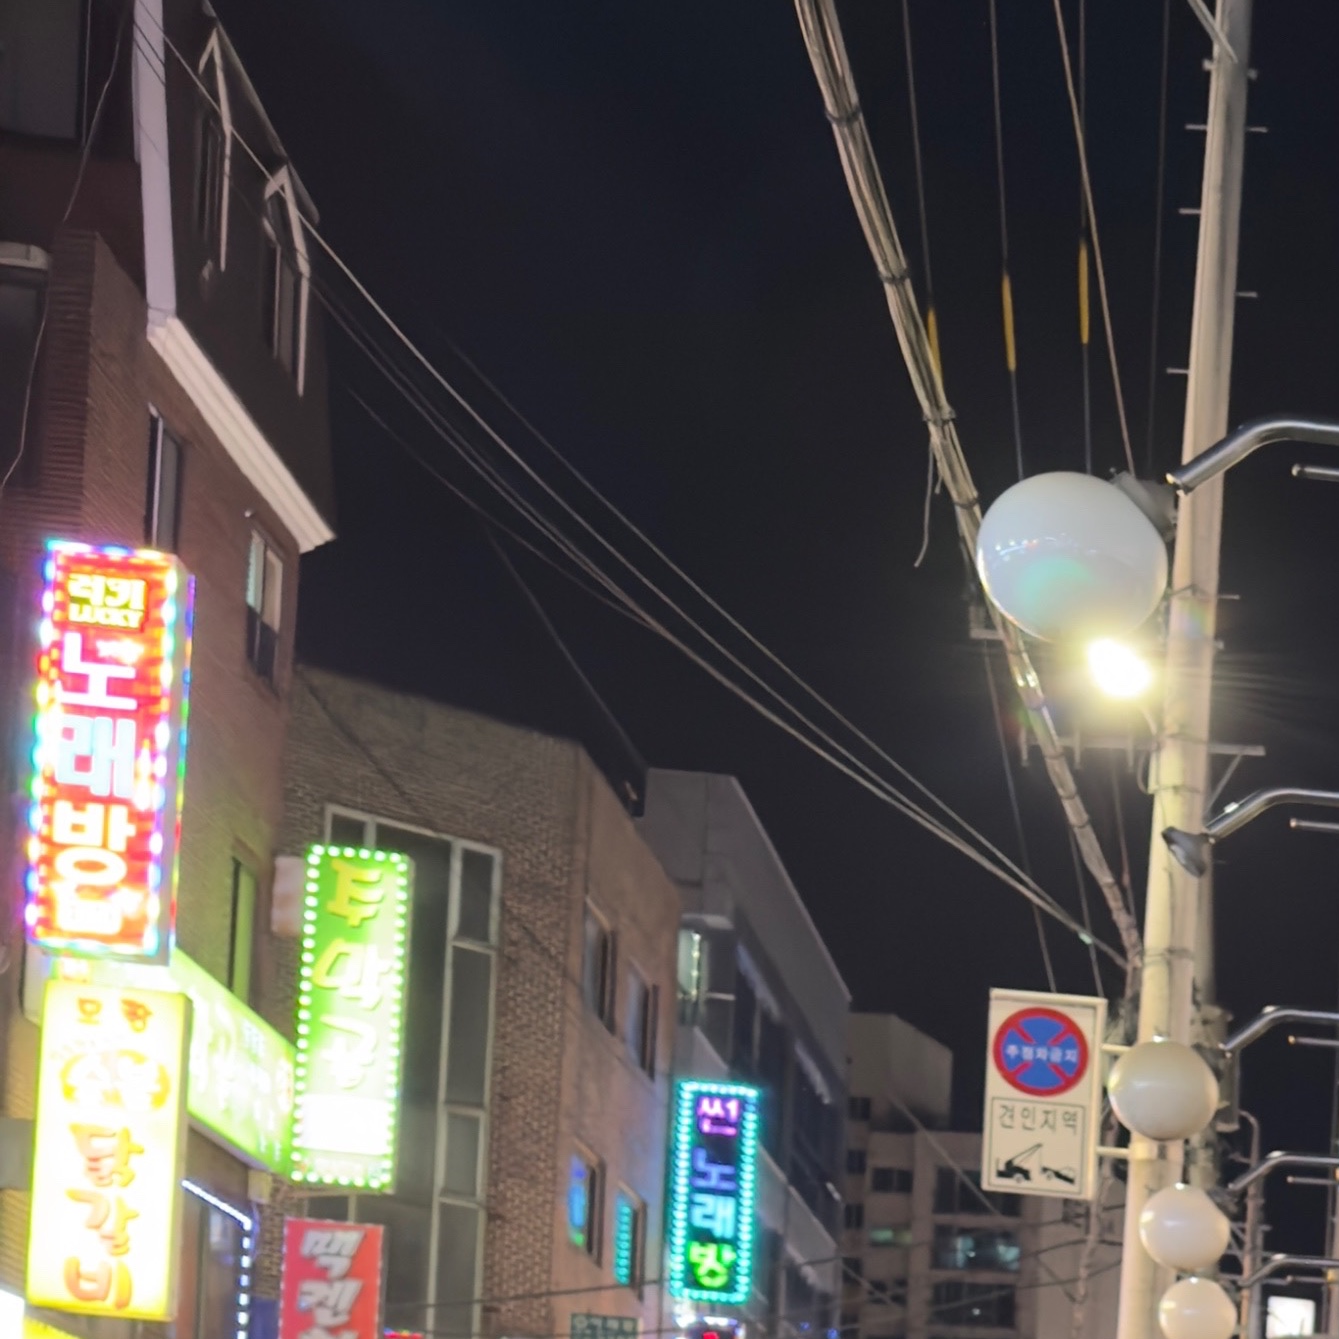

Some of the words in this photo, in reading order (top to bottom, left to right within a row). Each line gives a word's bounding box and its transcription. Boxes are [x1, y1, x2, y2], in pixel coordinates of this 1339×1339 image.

[68, 573, 147, 610] 럭키
[68, 602, 144, 629] LUCKY
[53, 632, 138, 886] 노래방
[999, 1104, 1078, 1136] 견인지역
[64, 1122, 145, 1311] 닭갈비
[688, 1146, 738, 1289] 노래방
